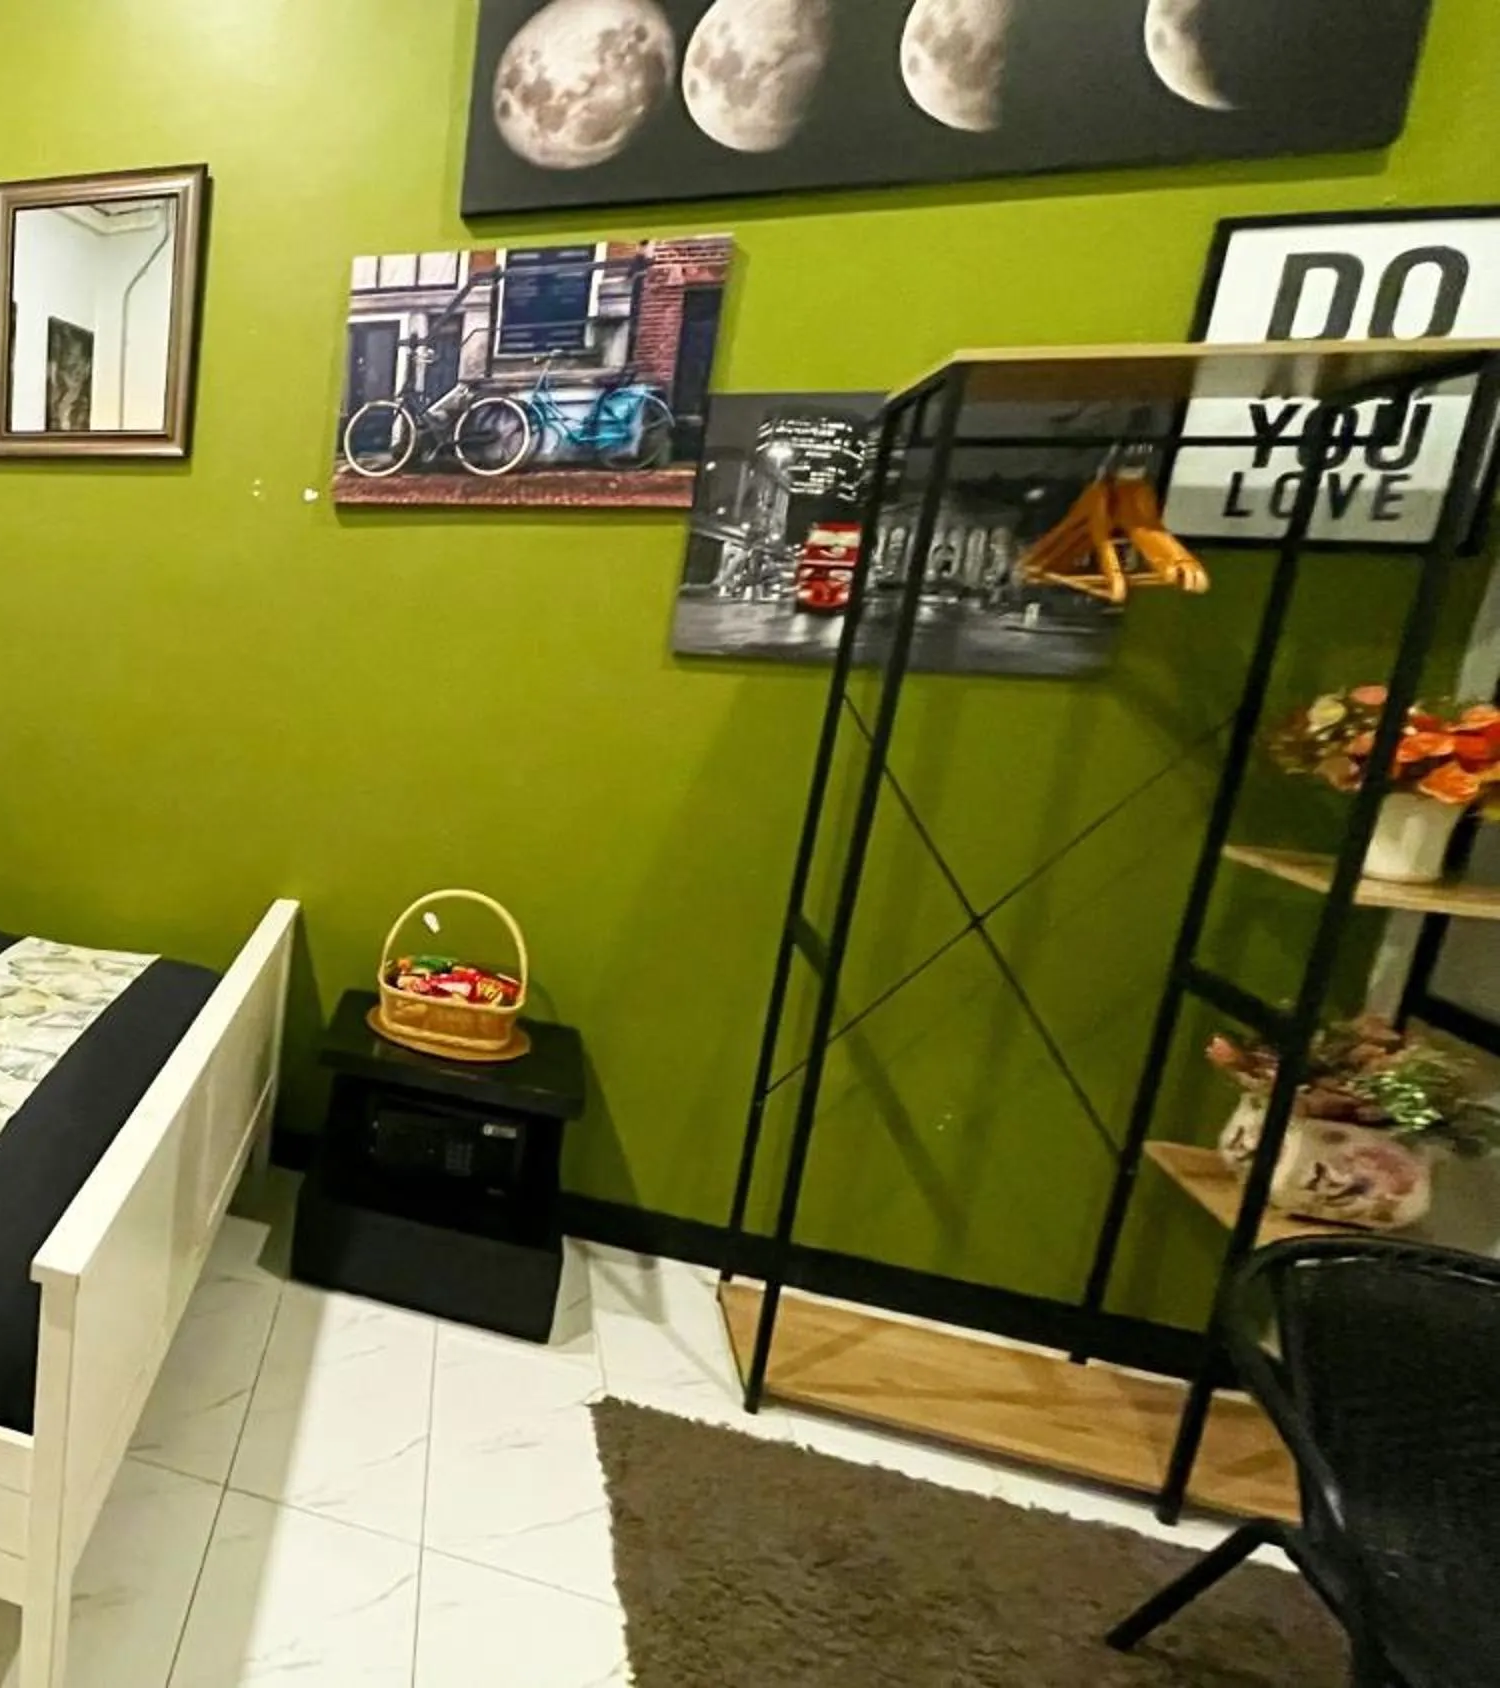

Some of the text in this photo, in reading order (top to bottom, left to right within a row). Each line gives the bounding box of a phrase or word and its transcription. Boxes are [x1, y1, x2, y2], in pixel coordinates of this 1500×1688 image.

[1266, 246, 1469, 341] DO
[1249, 402, 1432, 470] YOU
[1222, 472, 1411, 521] LOVE
